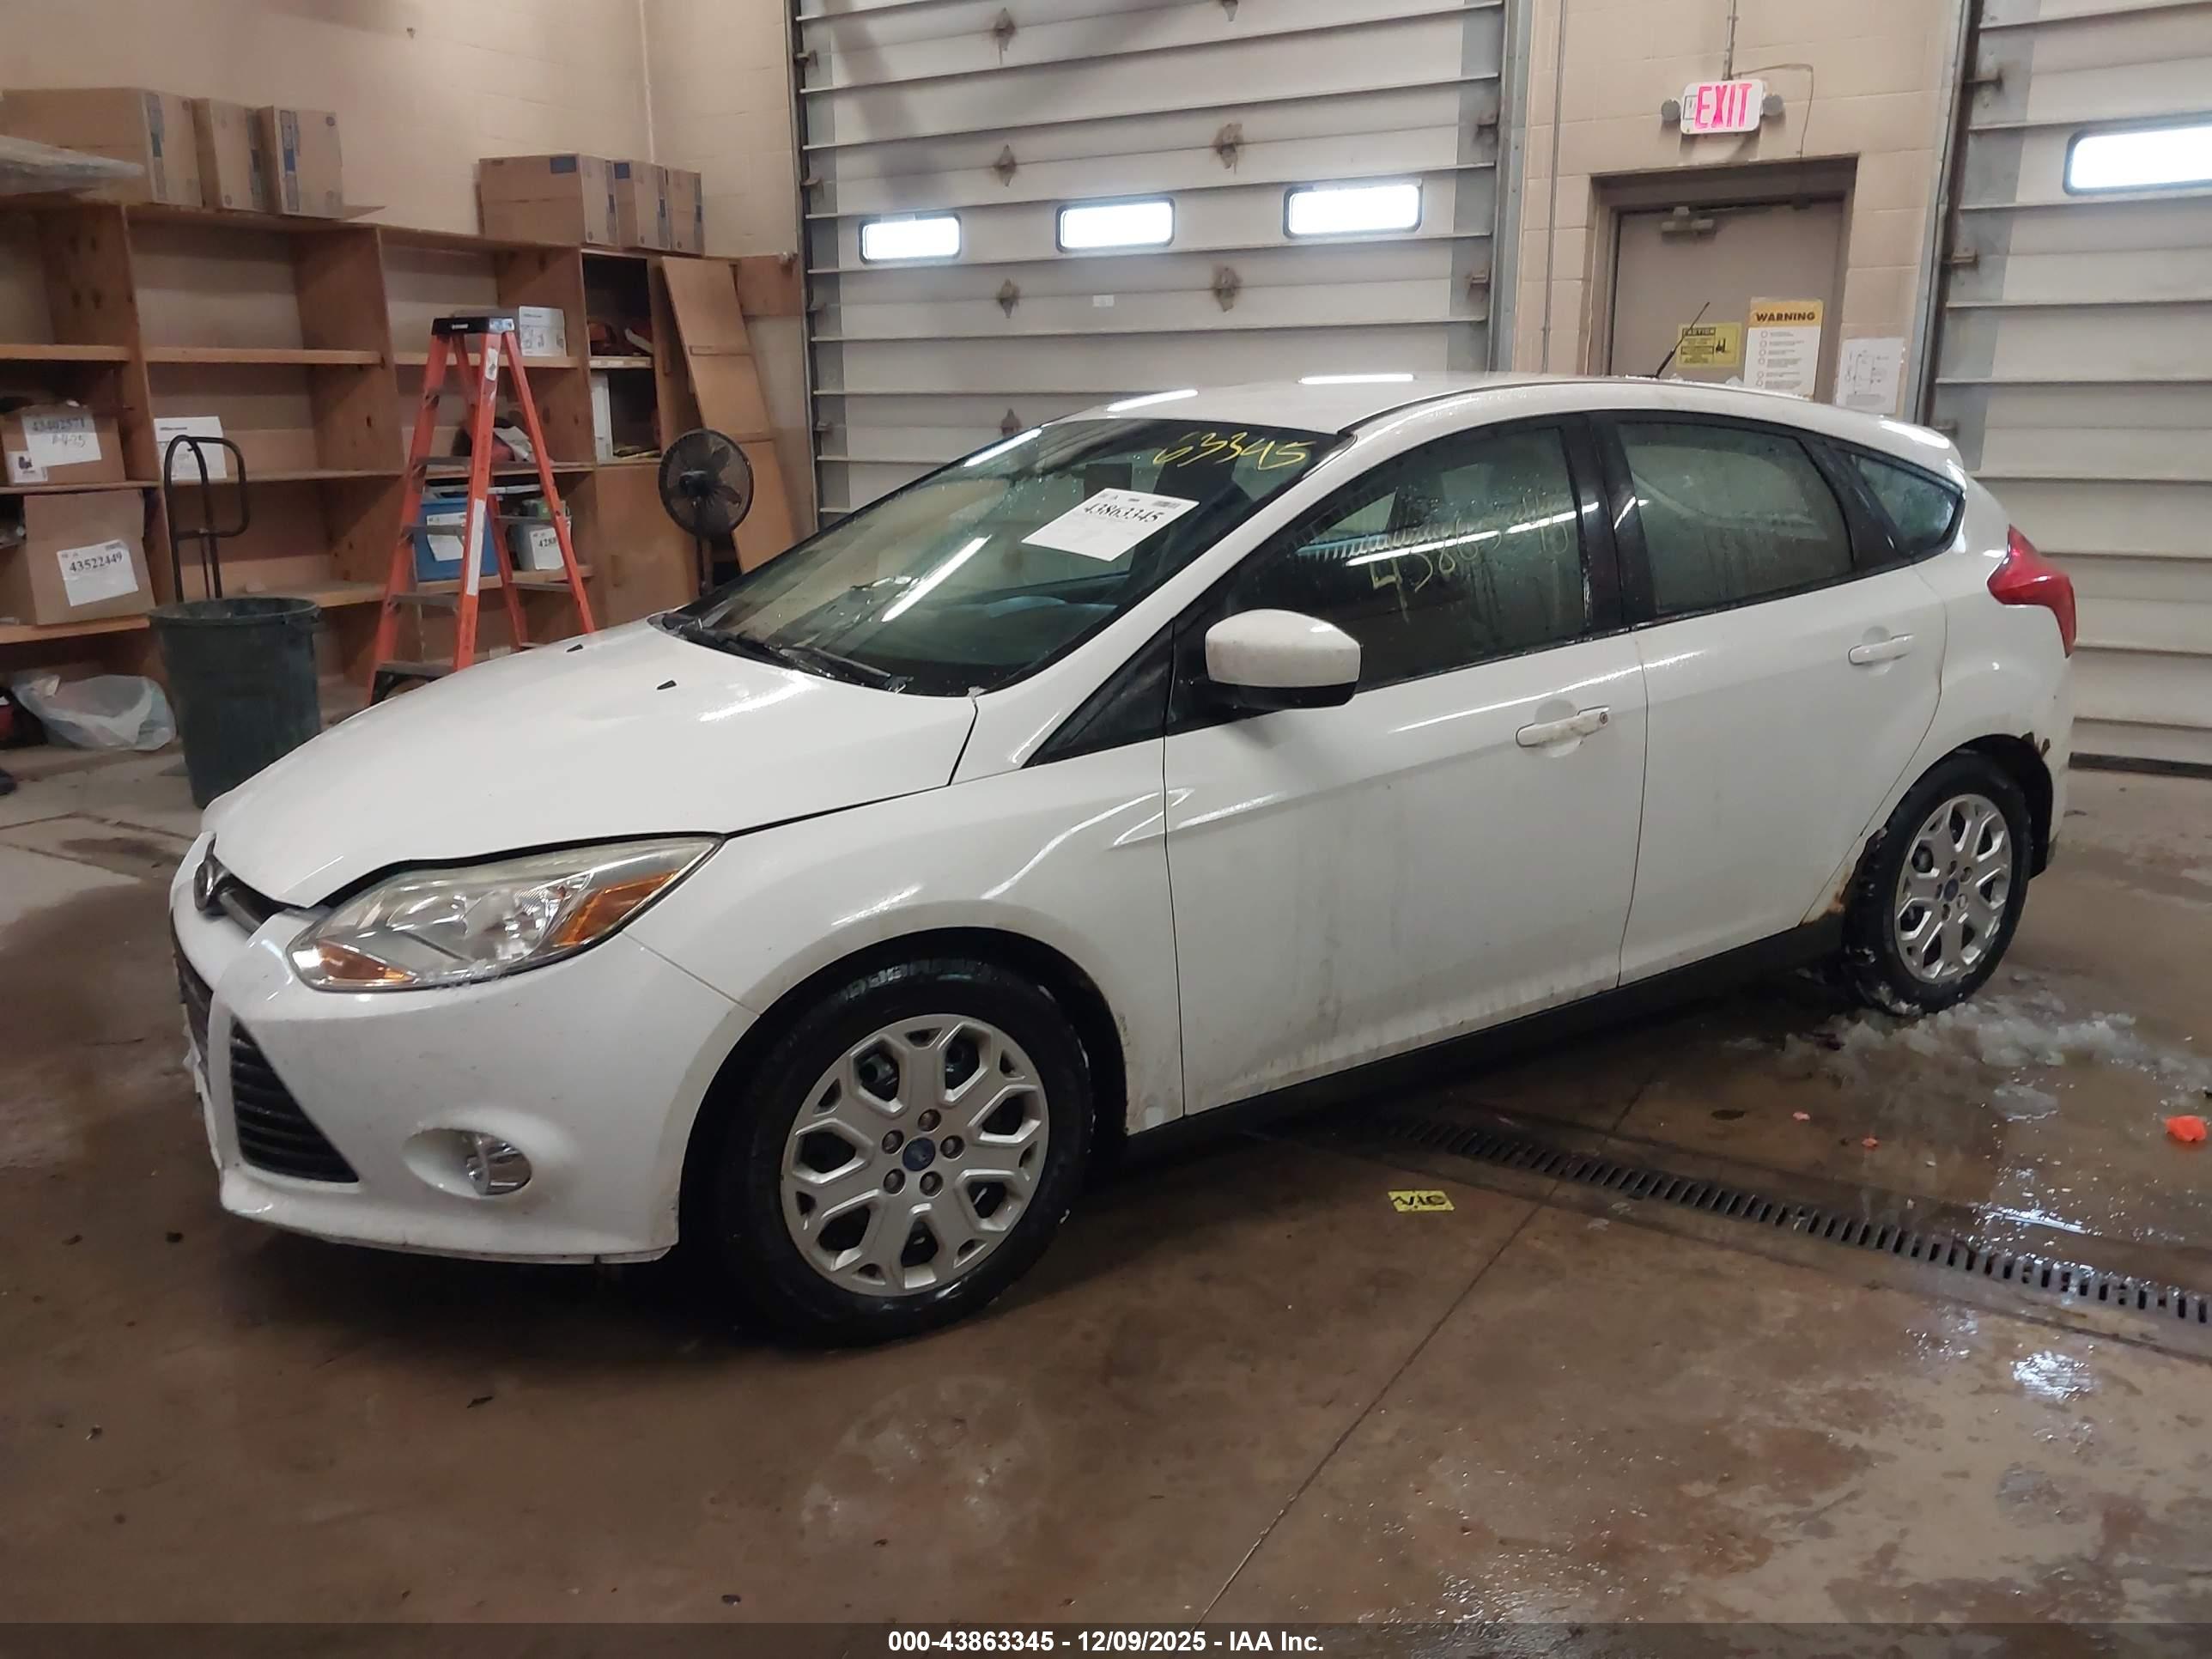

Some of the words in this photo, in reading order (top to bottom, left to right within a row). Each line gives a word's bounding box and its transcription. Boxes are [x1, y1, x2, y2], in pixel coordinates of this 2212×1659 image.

[1694, 83, 1753, 129] EXIT
[1756, 312, 1815, 322] WARNING
[1153, 432, 1316, 471] 63345
[69, 551, 123, 572] 43522449
